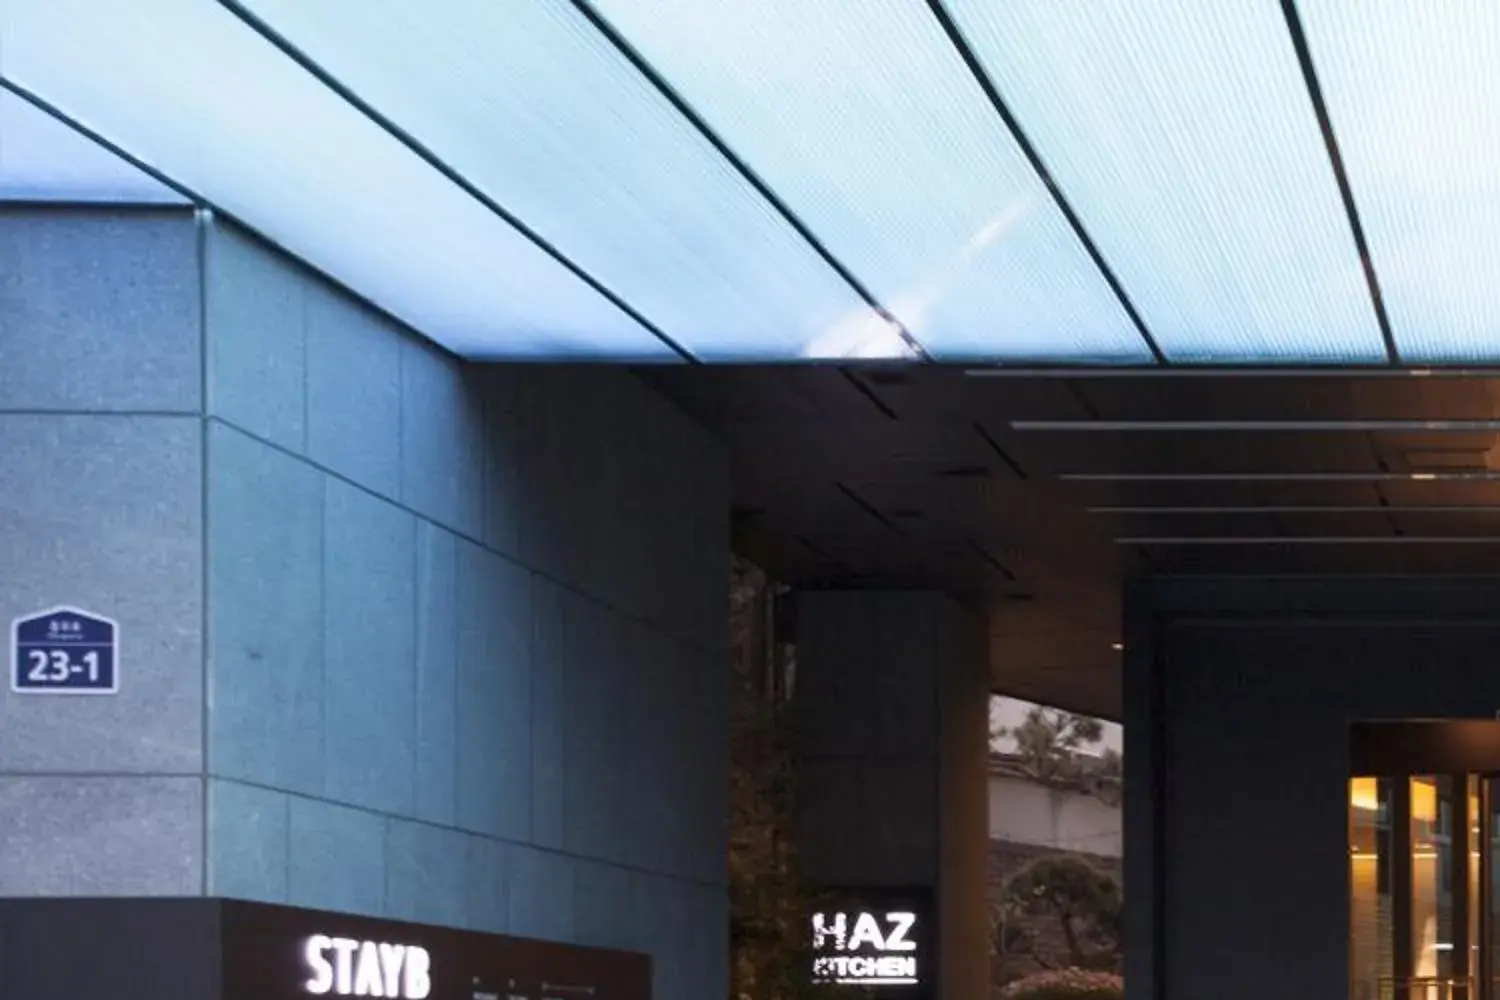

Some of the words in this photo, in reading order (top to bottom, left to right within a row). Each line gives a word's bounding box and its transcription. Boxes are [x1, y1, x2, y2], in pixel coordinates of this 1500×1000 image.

[28, 650, 99, 682] 23-1
[812, 911, 917, 951] HAZ
[305, 933, 431, 1000] STAYB
